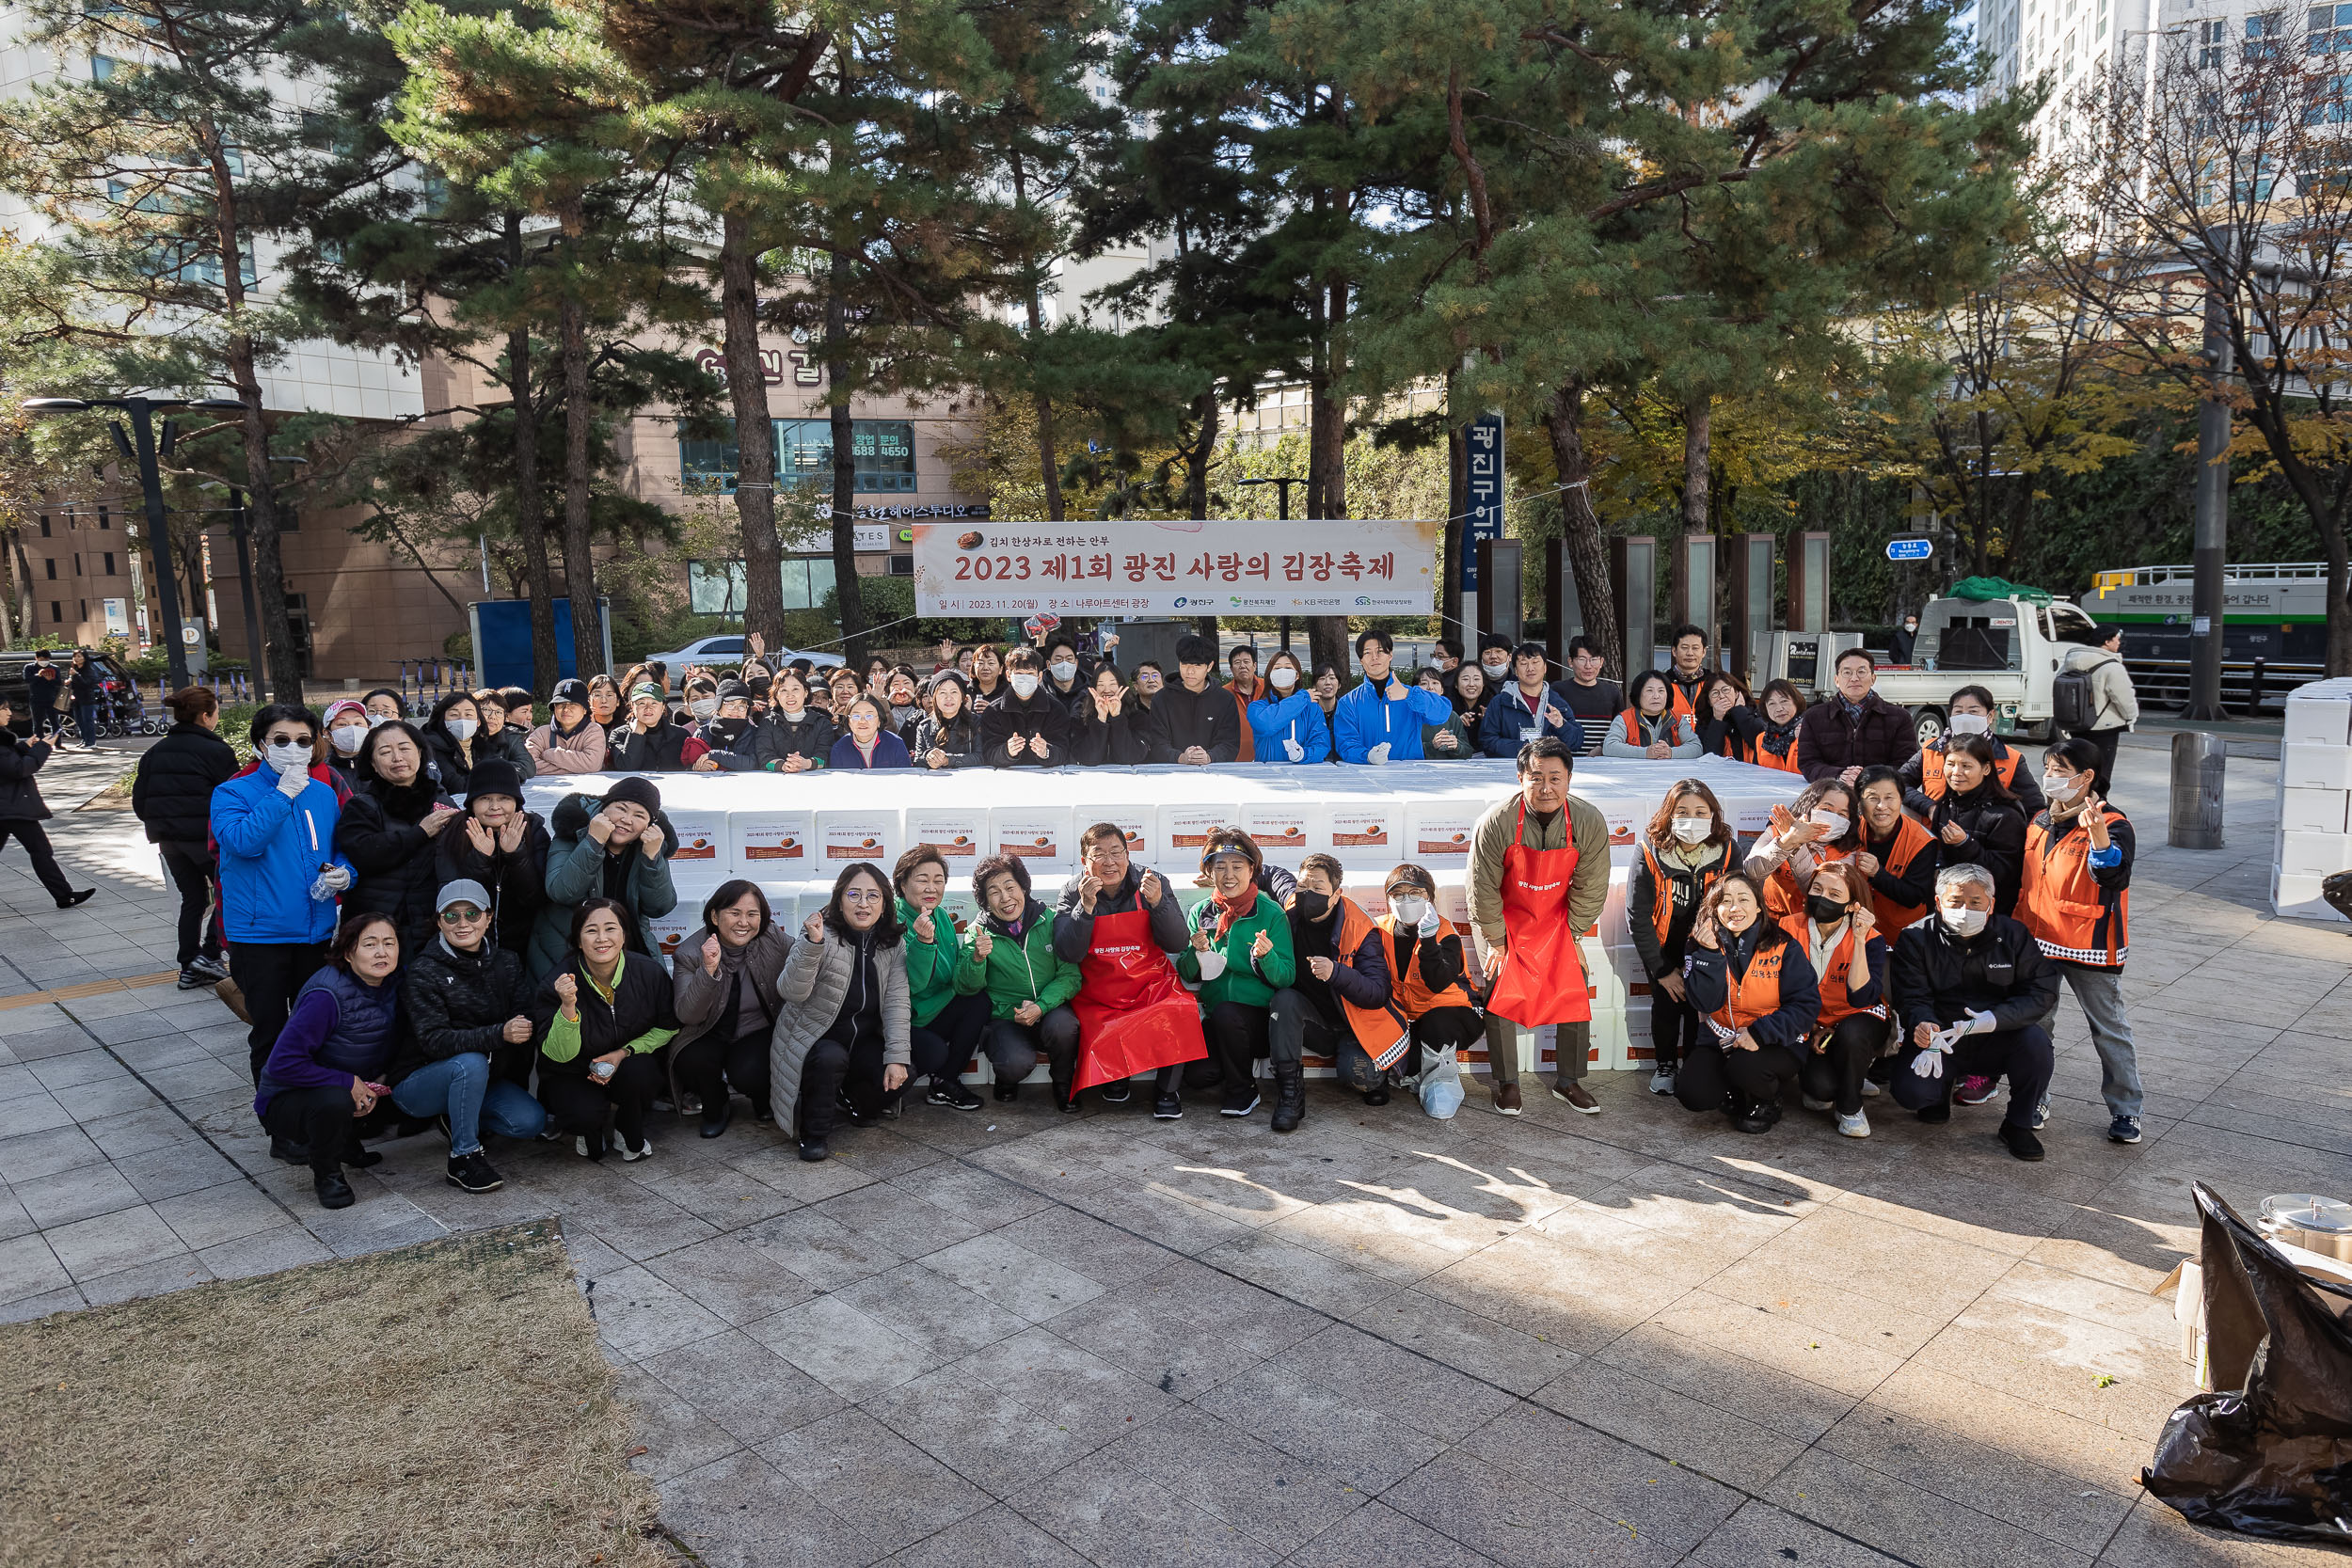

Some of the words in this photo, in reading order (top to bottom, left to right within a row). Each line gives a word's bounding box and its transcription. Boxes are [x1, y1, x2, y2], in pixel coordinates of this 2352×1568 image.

[855, 435, 875, 445] 창업
[880, 435, 898, 445] 문의
[881, 446, 909, 457] 4650
[990, 536, 1008, 547] 김치
[1011, 536, 1053, 547] 한상자로
[1056, 535, 1086, 546] 전하는
[1089, 535, 1110, 546] 안부
[954, 555, 1031, 581] 2023
[1041, 552, 1112, 582] 제1회
[1122, 552, 1176, 582] 광진
[1185, 551, 1270, 582] 사랑의
[1281, 550, 1394, 582] 김장축제
[1011, 599, 1039, 610] 20(월)
[1075, 598, 1129, 610] 나루아트센터
[1131, 598, 1150, 610] 광장
[185, 630, 195, 641] P
[1751, 969, 1779, 978] 의용소방
